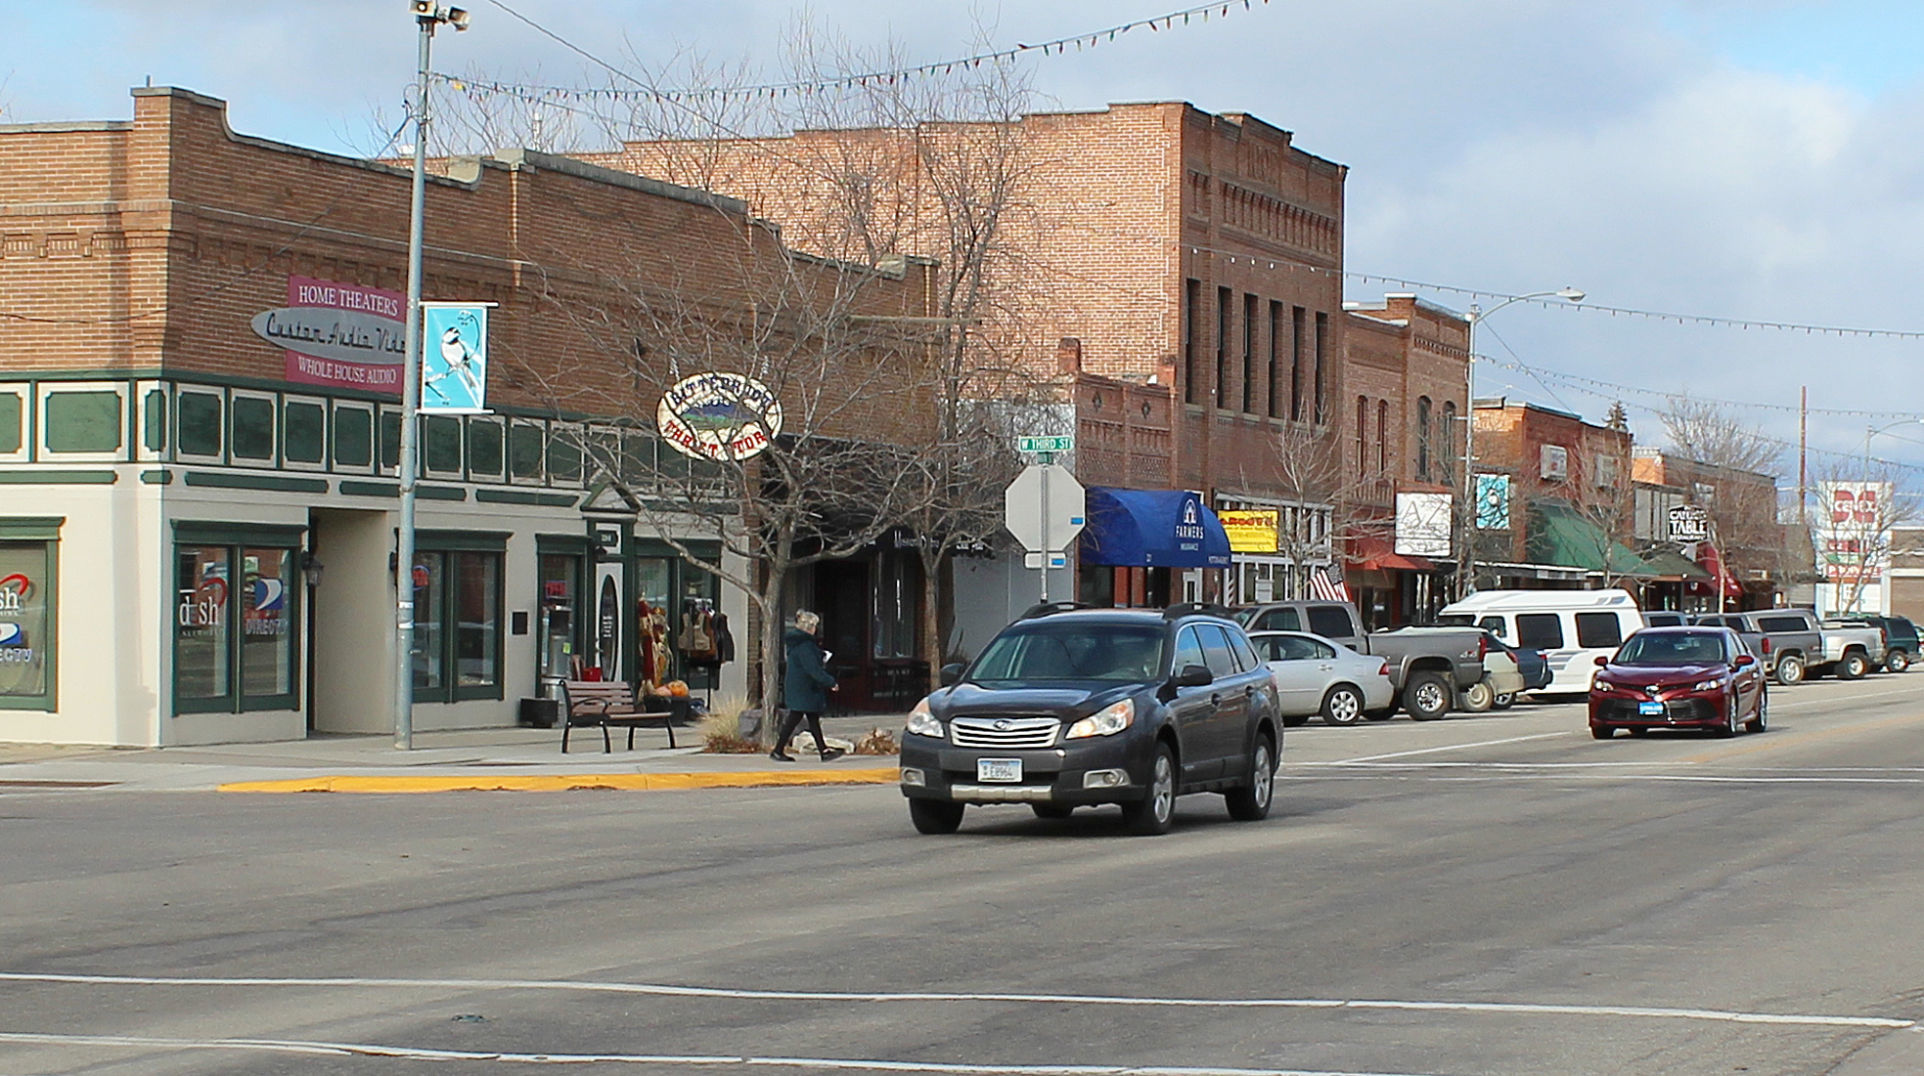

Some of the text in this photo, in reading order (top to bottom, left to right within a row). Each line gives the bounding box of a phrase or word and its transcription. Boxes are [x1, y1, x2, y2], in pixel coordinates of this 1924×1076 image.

[299, 285, 399, 317] HOME THEATERS
[327, 321, 374, 349] Audio
[297, 355, 397, 385] WHOLE HOUSE AUDIO
[663, 420, 719, 458] THRFT
[1021, 438, 1070, 450] W THIRD ST
[1175, 525, 1204, 540] FARMERS
[179, 595, 219, 626] dsh
